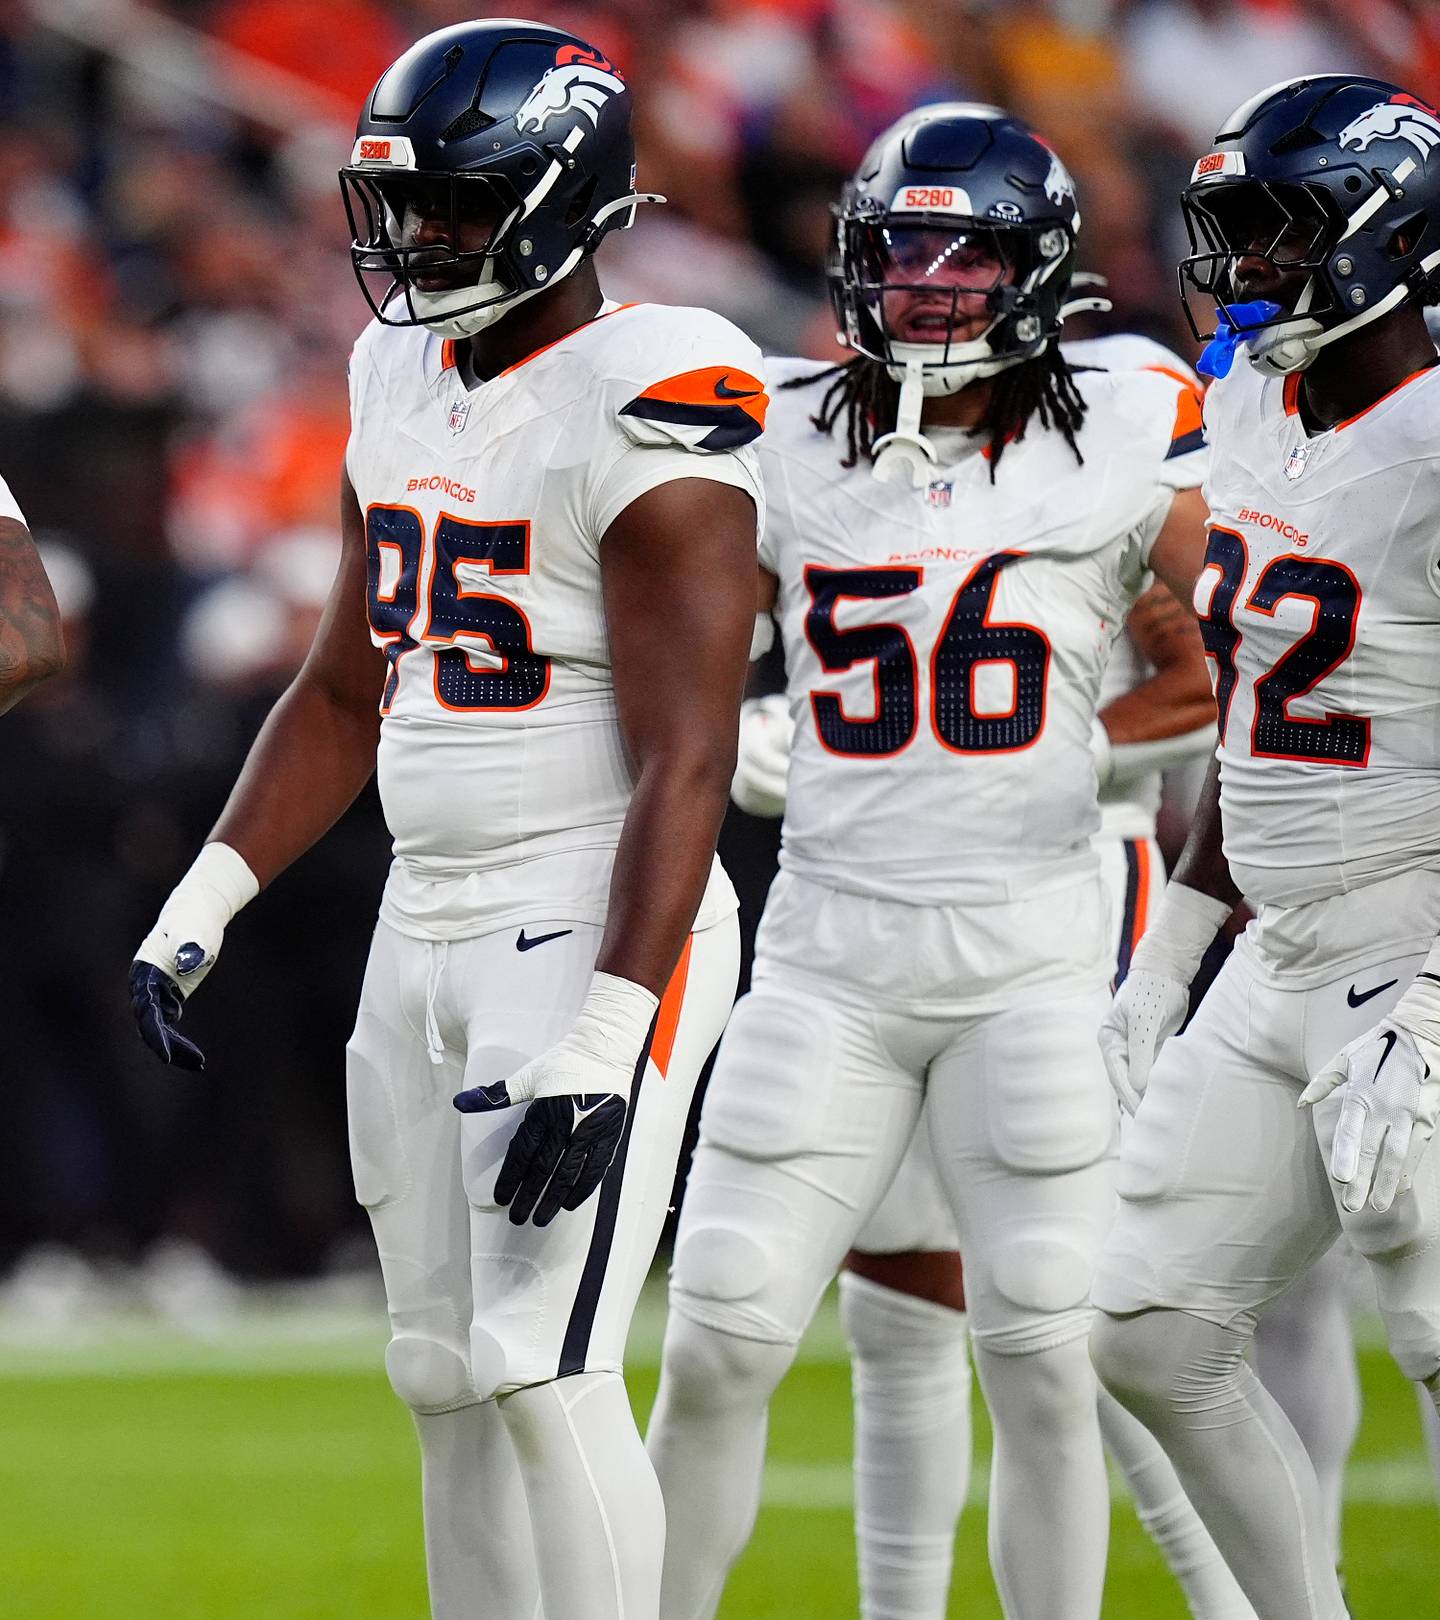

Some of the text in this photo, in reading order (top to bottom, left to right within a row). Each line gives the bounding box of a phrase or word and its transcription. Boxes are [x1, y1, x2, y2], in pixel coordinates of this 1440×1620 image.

[360, 141, 391, 159] 5280
[905, 189, 953, 207] 5280
[407, 476, 476, 503] BRONCOS
[1239, 508, 1309, 546] BRONCOS
[365, 502, 551, 716] 95
[803, 548, 1051, 760] 56
[1193, 523, 1372, 769] 92
